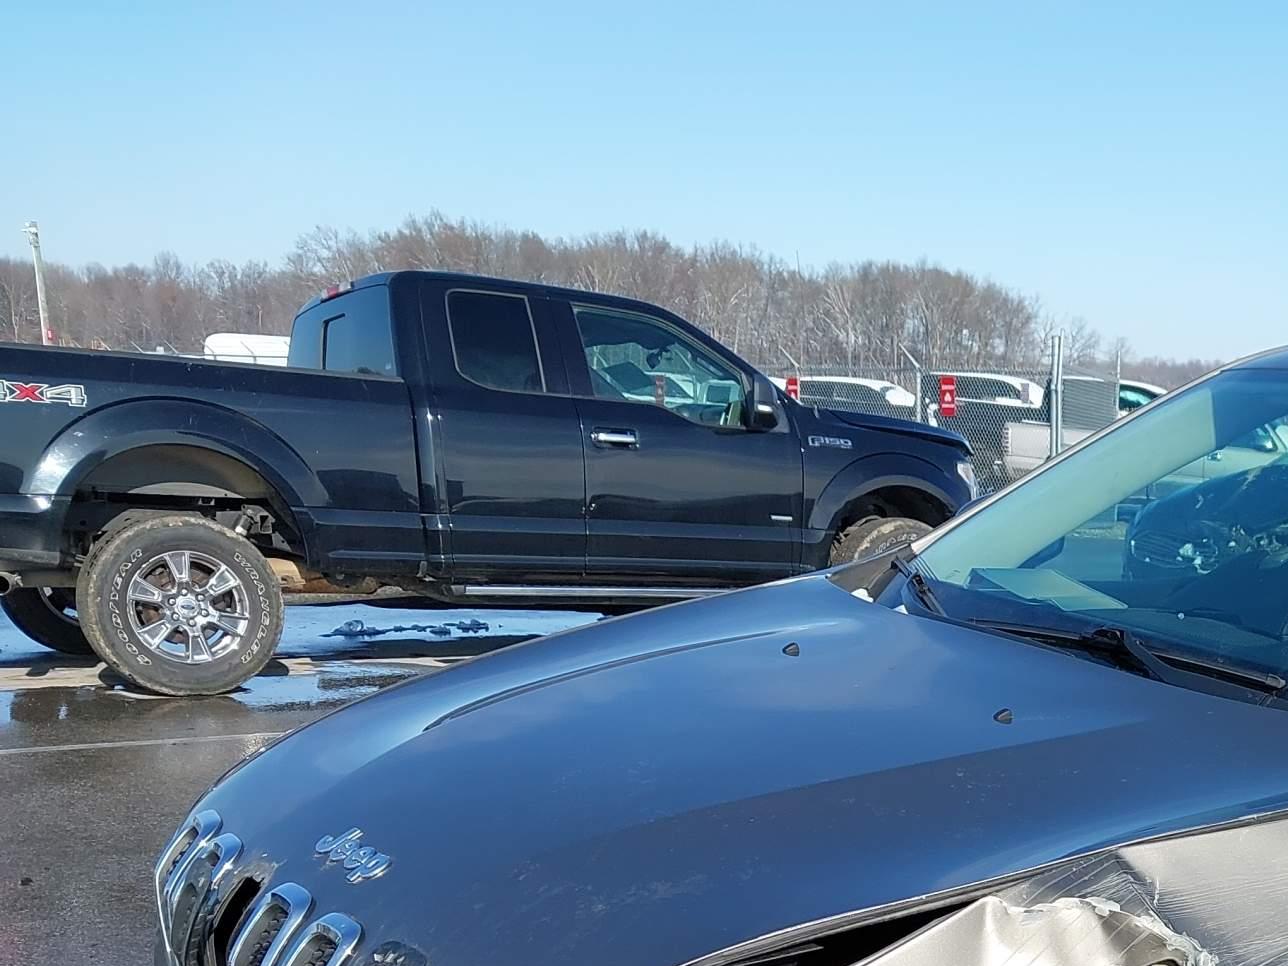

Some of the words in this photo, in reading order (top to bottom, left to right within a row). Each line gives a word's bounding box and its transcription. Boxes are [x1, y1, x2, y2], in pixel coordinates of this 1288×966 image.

[0, 380, 87, 407] X4
[109, 549, 152, 666] GOODYEAR
[234, 552, 271, 665] WRANGLER
[315, 827, 391, 882] Jeep
